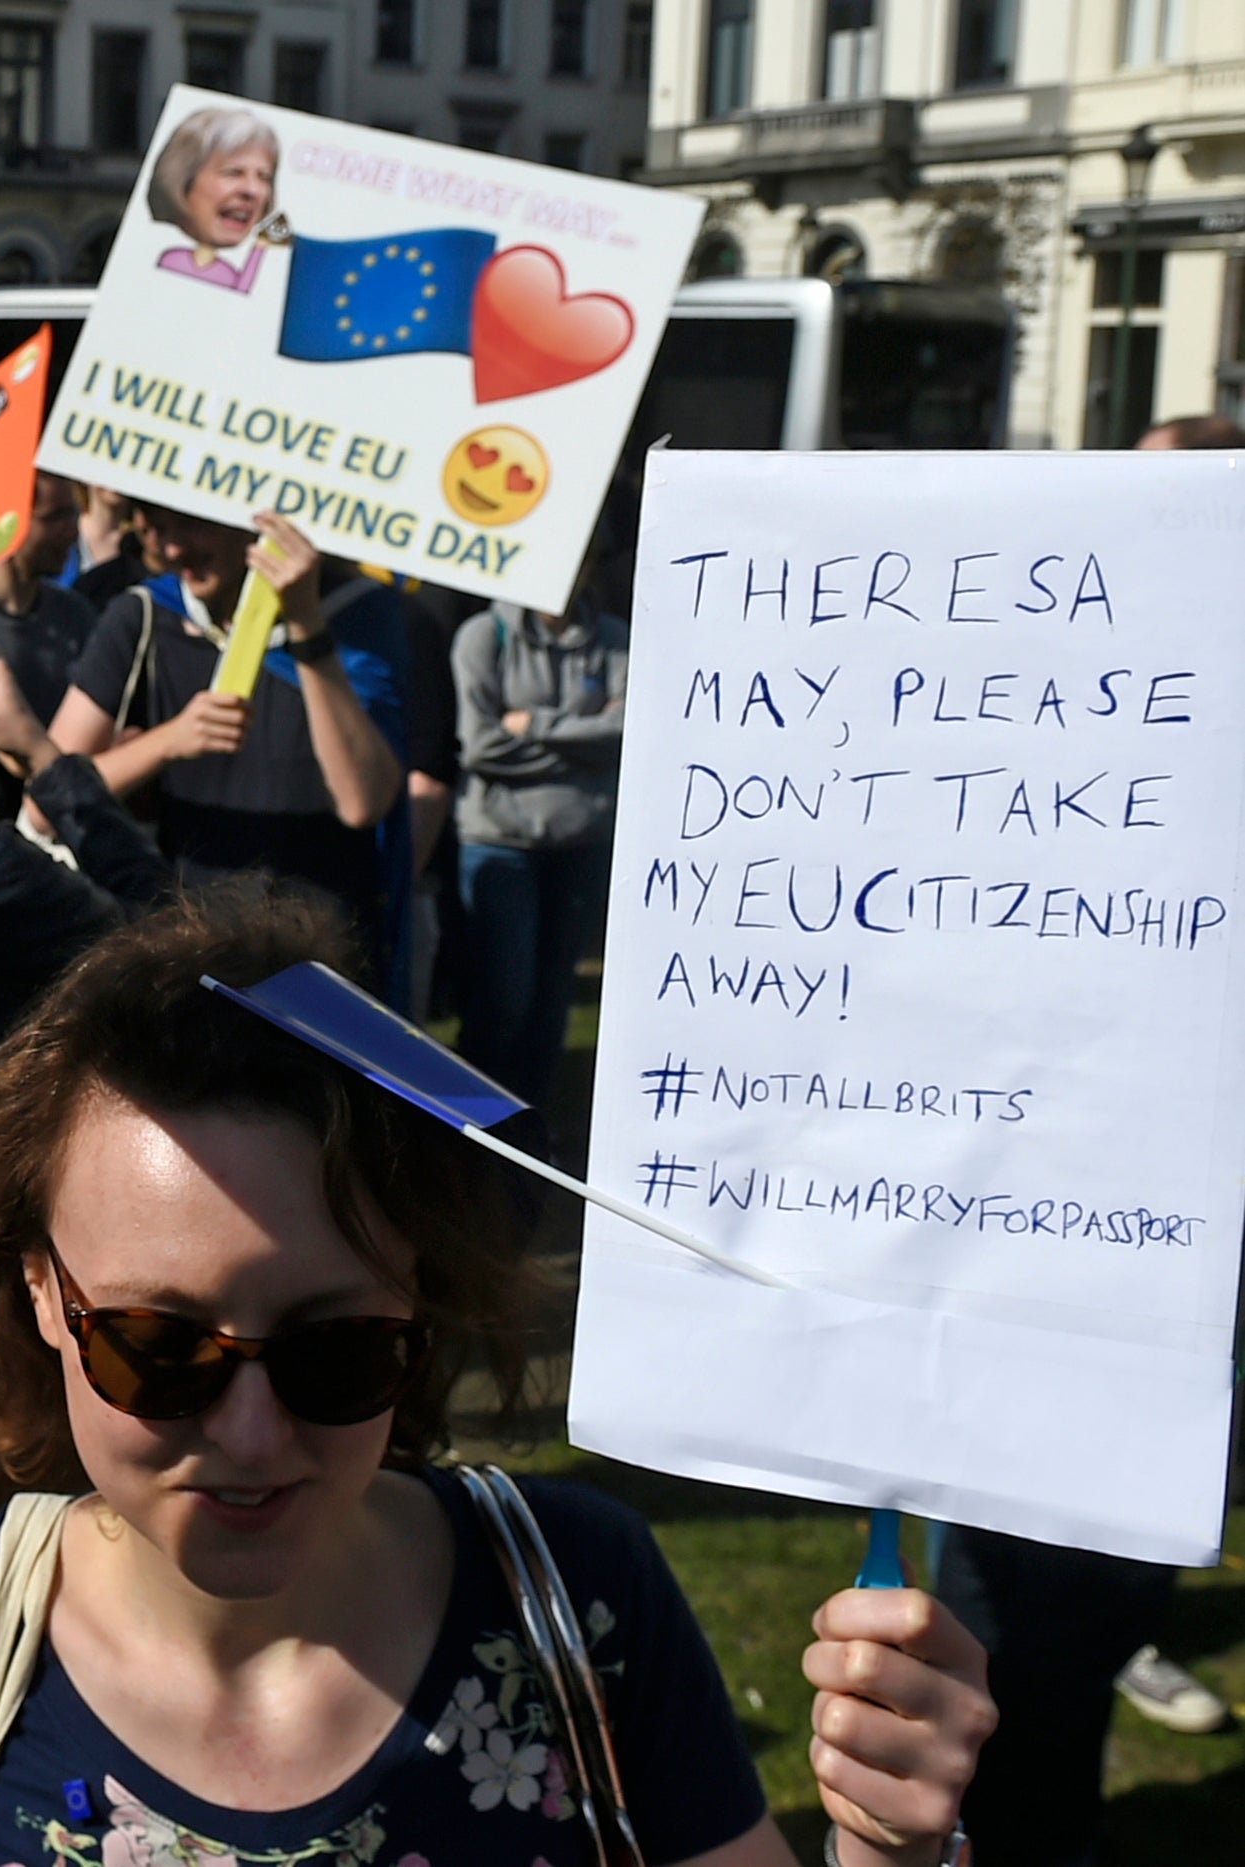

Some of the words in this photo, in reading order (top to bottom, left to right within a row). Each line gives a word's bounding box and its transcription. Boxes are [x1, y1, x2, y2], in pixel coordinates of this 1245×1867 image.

[83, 361, 101, 394] I
[113, 368, 206, 428] WILL
[221, 402, 336, 462] LOVE
[342, 436, 408, 481] EU
[61, 413, 180, 482] UNTIL
[194, 456, 273, 504] MY
[274, 480, 418, 547] DYING
[427, 523, 522, 574] DAY
[669, 550, 1113, 628] THERESA
[683, 664, 850, 749] MAY,
[892, 666, 1197, 729] PLEASE
[680, 763, 911, 840] DON'T
[932, 767, 1173, 837] TAKE
[643, 857, 719, 926] MY
[733, 857, 843, 933] EU
[853, 867, 1227, 951] CITIZENSHIP
[657, 951, 850, 1022] AWAY!
[640, 1051, 1034, 1123] #NOTALLBRITS
[635, 1149, 1207, 1248] #WILLMARRYFORPASSPORT
